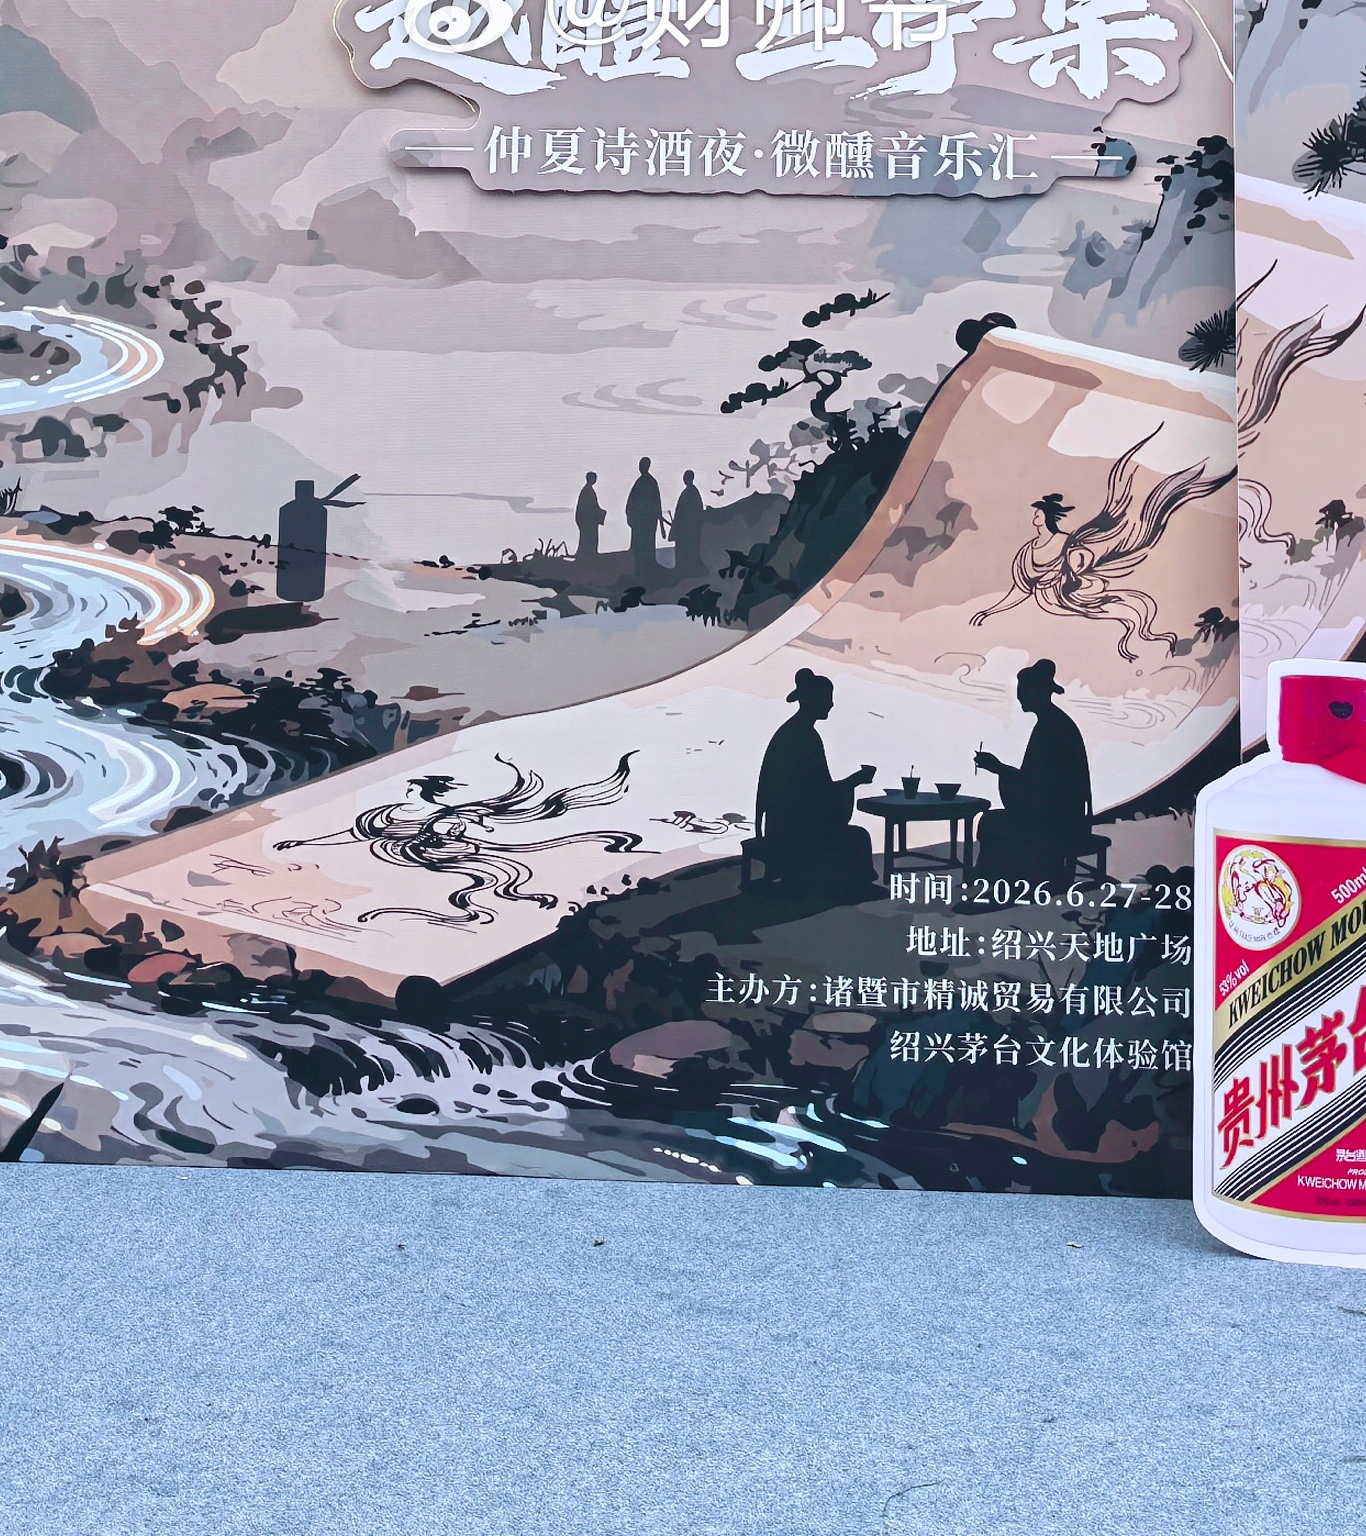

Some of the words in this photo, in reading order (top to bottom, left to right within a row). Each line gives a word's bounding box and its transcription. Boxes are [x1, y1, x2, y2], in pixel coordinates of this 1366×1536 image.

[483, 124, 1039, 182] 仲夏诗酒夜·微醺音乐汇
[1229, 930, 1326, 1029] KWEICHOW
[889, 1029, 1193, 1073] 绍兴茅台文化体验馆
[1297, 1175, 1357, 1191] KWEICHOW
